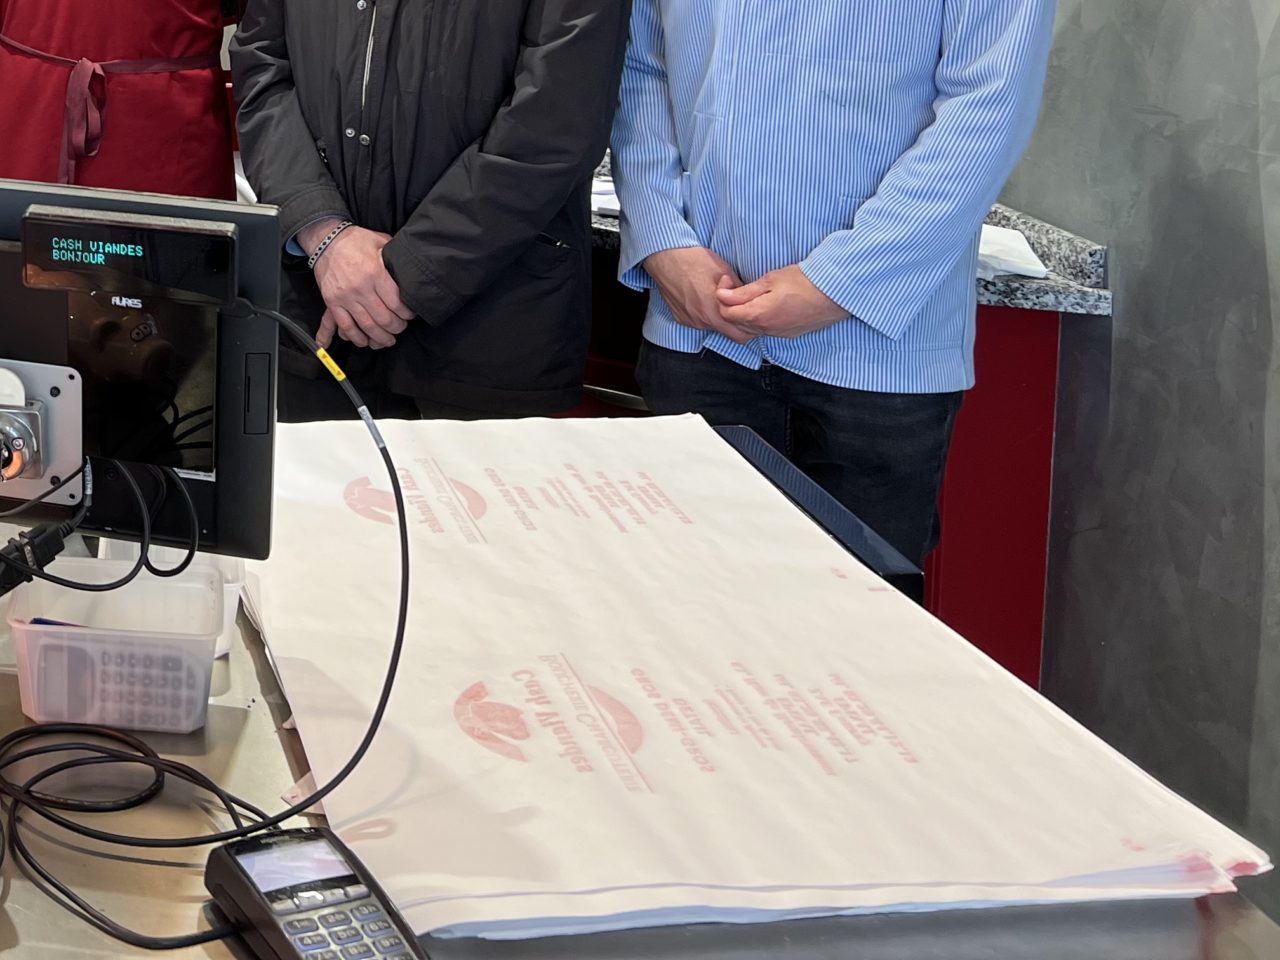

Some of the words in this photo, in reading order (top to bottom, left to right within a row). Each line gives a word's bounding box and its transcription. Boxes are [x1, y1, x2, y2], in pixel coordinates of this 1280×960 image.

[52, 237, 83, 251] CASH
[89, 240, 144, 257] VIANDES
[52, 251, 106, 265] BONJOUR
